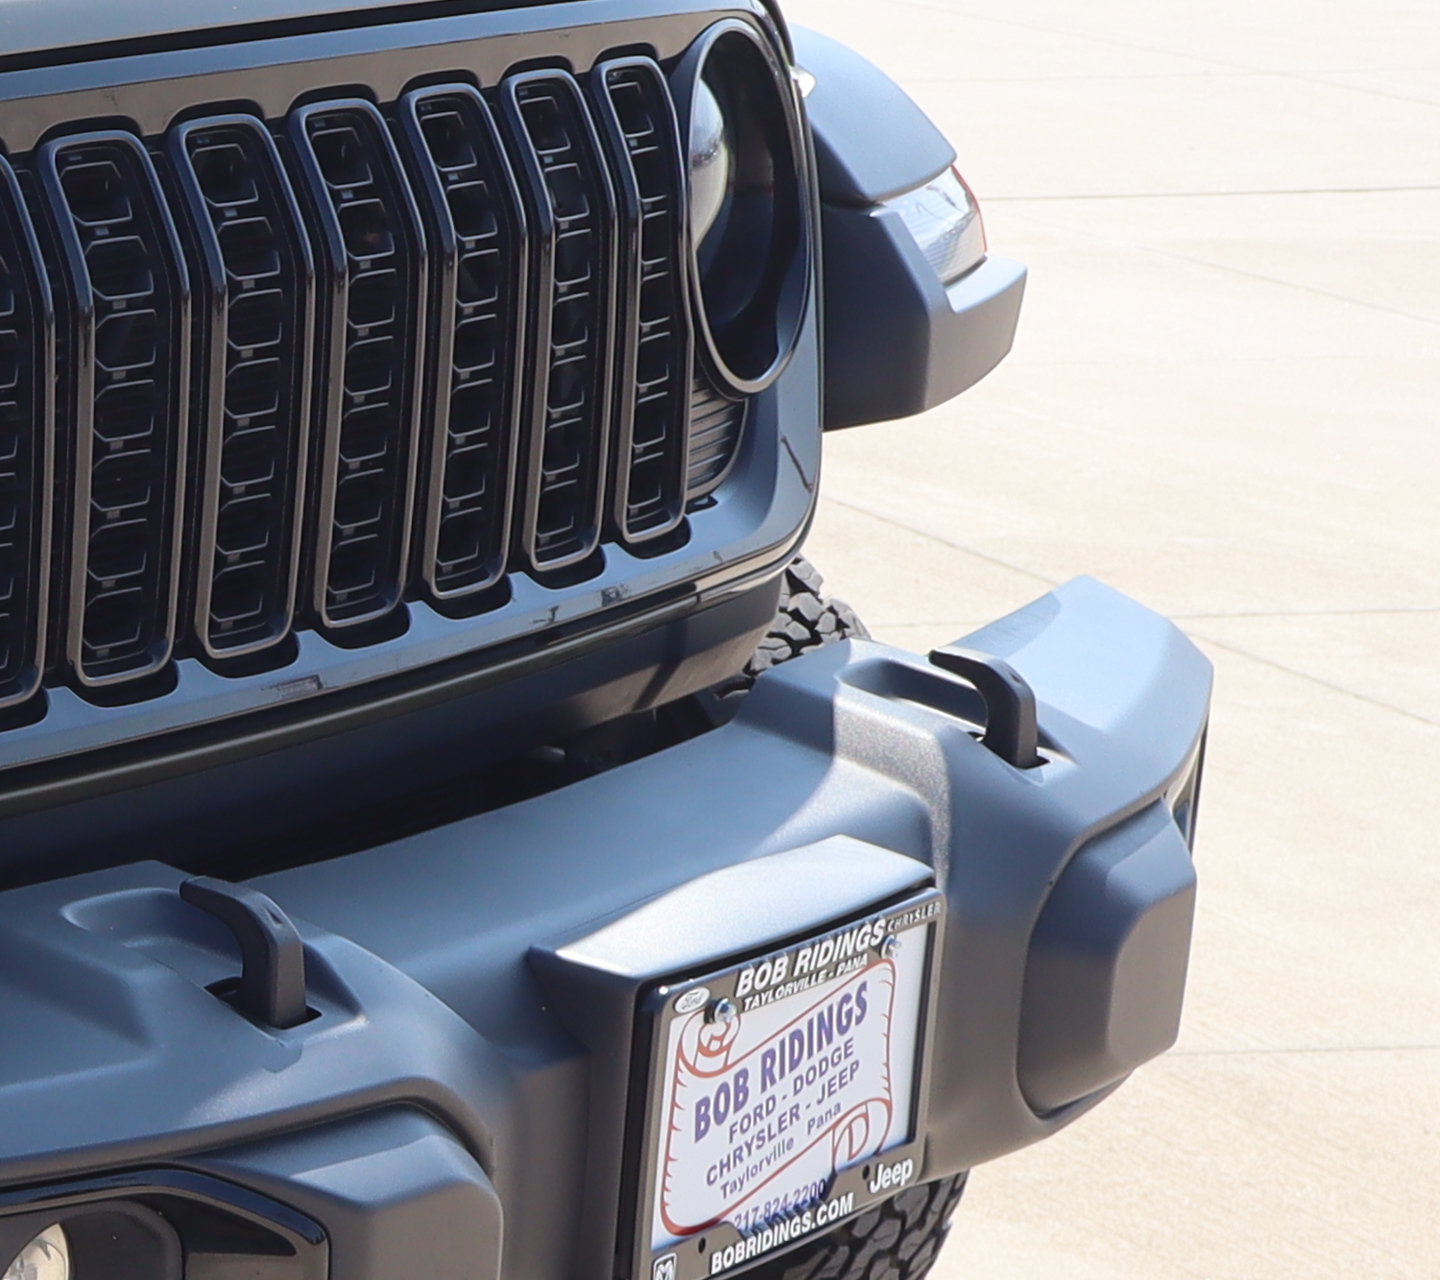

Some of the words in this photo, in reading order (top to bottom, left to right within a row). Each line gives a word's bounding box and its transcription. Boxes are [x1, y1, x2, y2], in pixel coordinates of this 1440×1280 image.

[888, 901, 941, 932] CHRYSLER
[735, 956, 789, 997] BOB
[793, 919, 886, 977] RIDINGS
[743, 971, 826, 1012] TAYLORVILLE
[837, 953, 868, 977] PANA
[695, 1068, 749, 1144] BOB
[761, 981, 867, 1094] RIDINGS
[729, 1094, 776, 1144] FORD
[793, 1037, 854, 1097] DODGE
[706, 1103, 800, 1186] CHRYSLER
[816, 1059, 860, 1105] JEEP
[720, 1137, 794, 1200] Taylorville
[807, 1102, 841, 1136] Pana
[734, 1178, 827, 1230] 217-824-2200
[869, 1158, 913, 1193] Jeep
[710, 1192, 854, 1274] BOBRIDINGS.COM
